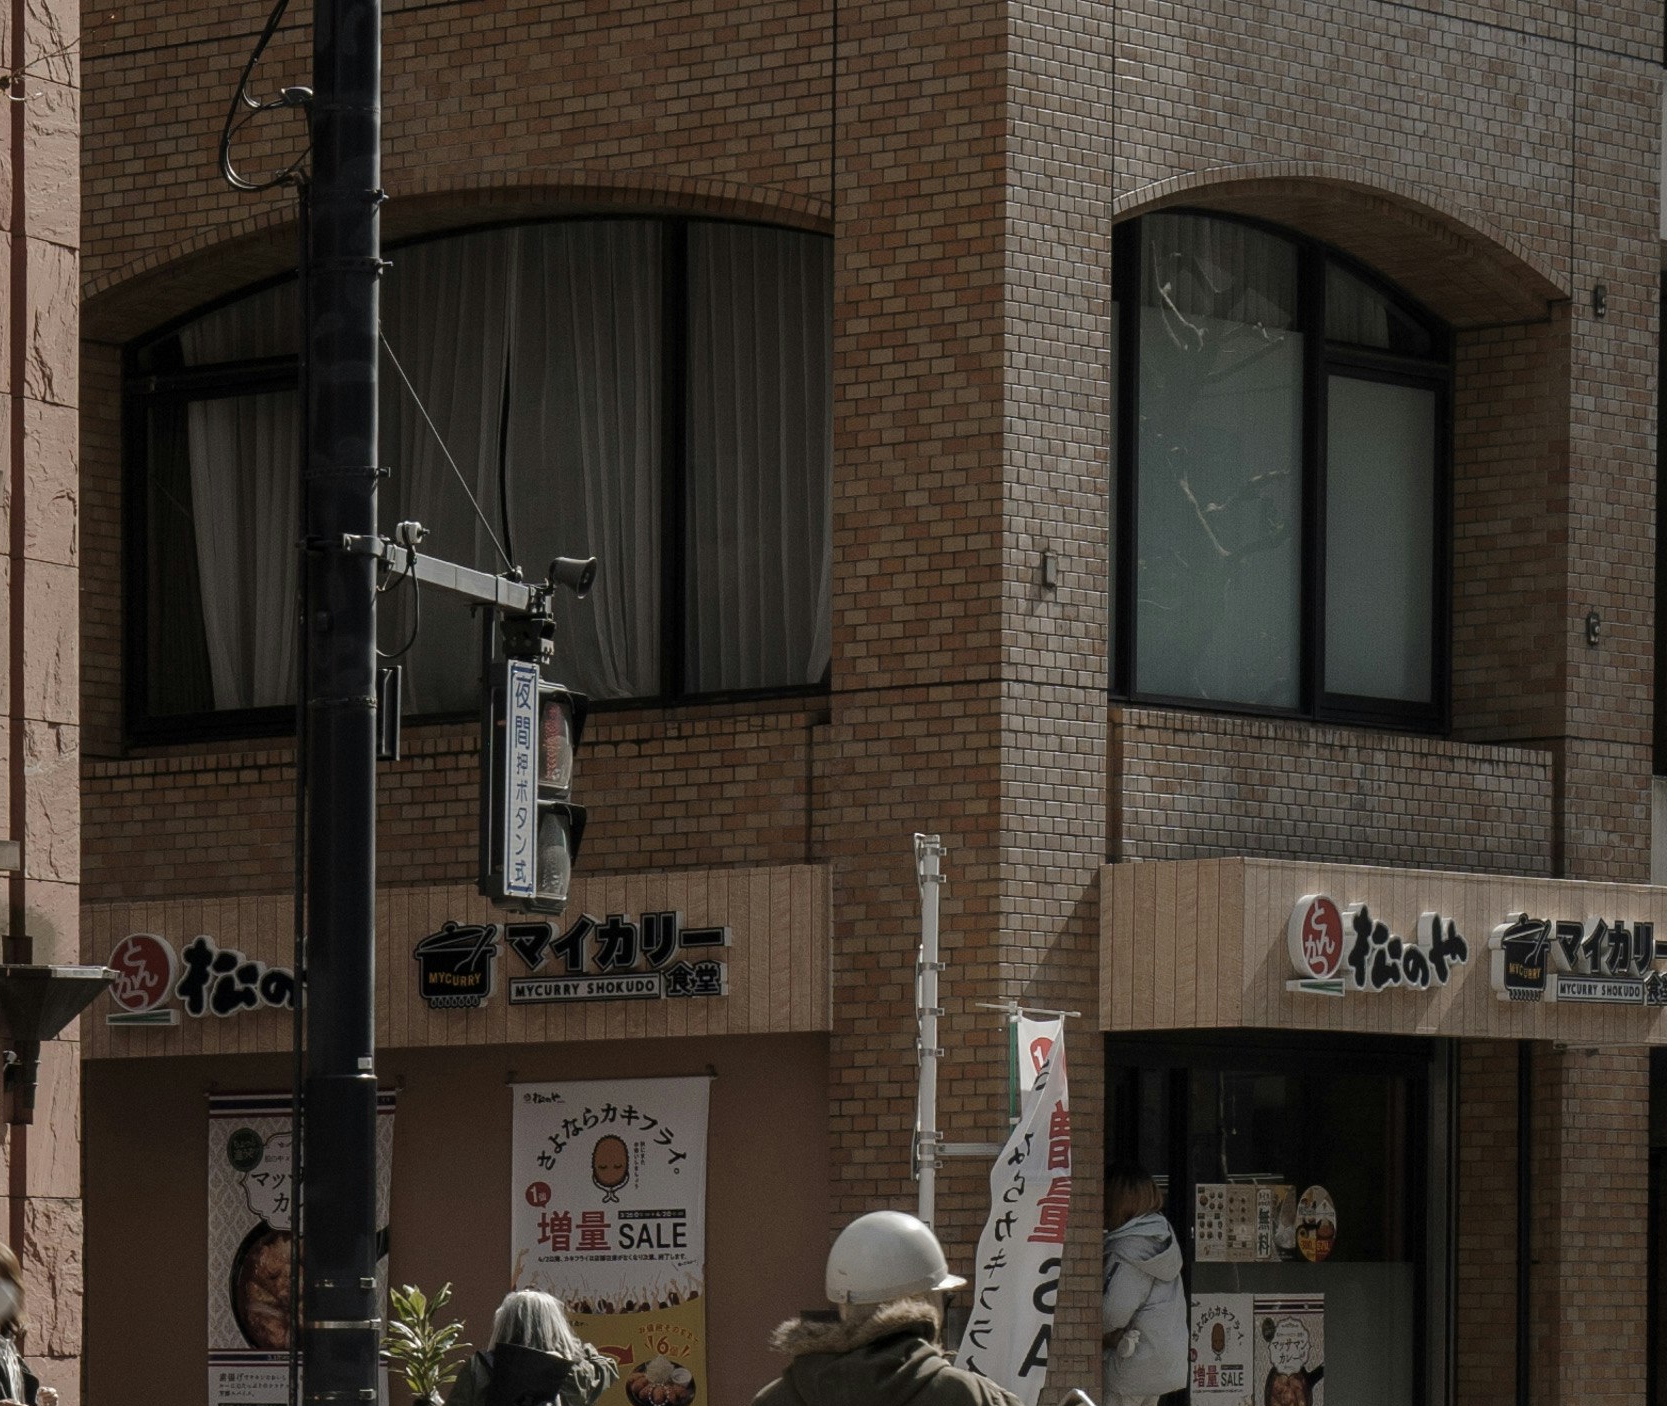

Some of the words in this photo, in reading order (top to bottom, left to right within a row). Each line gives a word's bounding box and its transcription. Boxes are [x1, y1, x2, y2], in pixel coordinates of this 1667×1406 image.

[505, 911, 725, 972] マイカリー
[1304, 898, 1335, 976] とんかつ
[1348, 904, 1467, 988] 松のや
[114, 937, 159, 1011] とんかつ
[428, 971, 482, 987] MYCURRY
[664, 960, 723, 996] 食堂
[1509, 961, 1542, 979] MYCURRY
[515, 982, 580, 997] MYCURRY
[587, 980, 655, 994] SHOKUDO
[1560, 983, 1598, 995] MYCURRY
[1602, 984, 1641, 997] SHOKUDO
[537, 1103, 687, 1175] さよならカキフライ。
[251, 1172, 293, 1190] マッ
[537, 1211, 611, 1252] 増量
[619, 1222, 687, 1250] SALE
[1193, 1364, 1218, 1387] 増量
[1221, 1372, 1244, 1387] SALE
